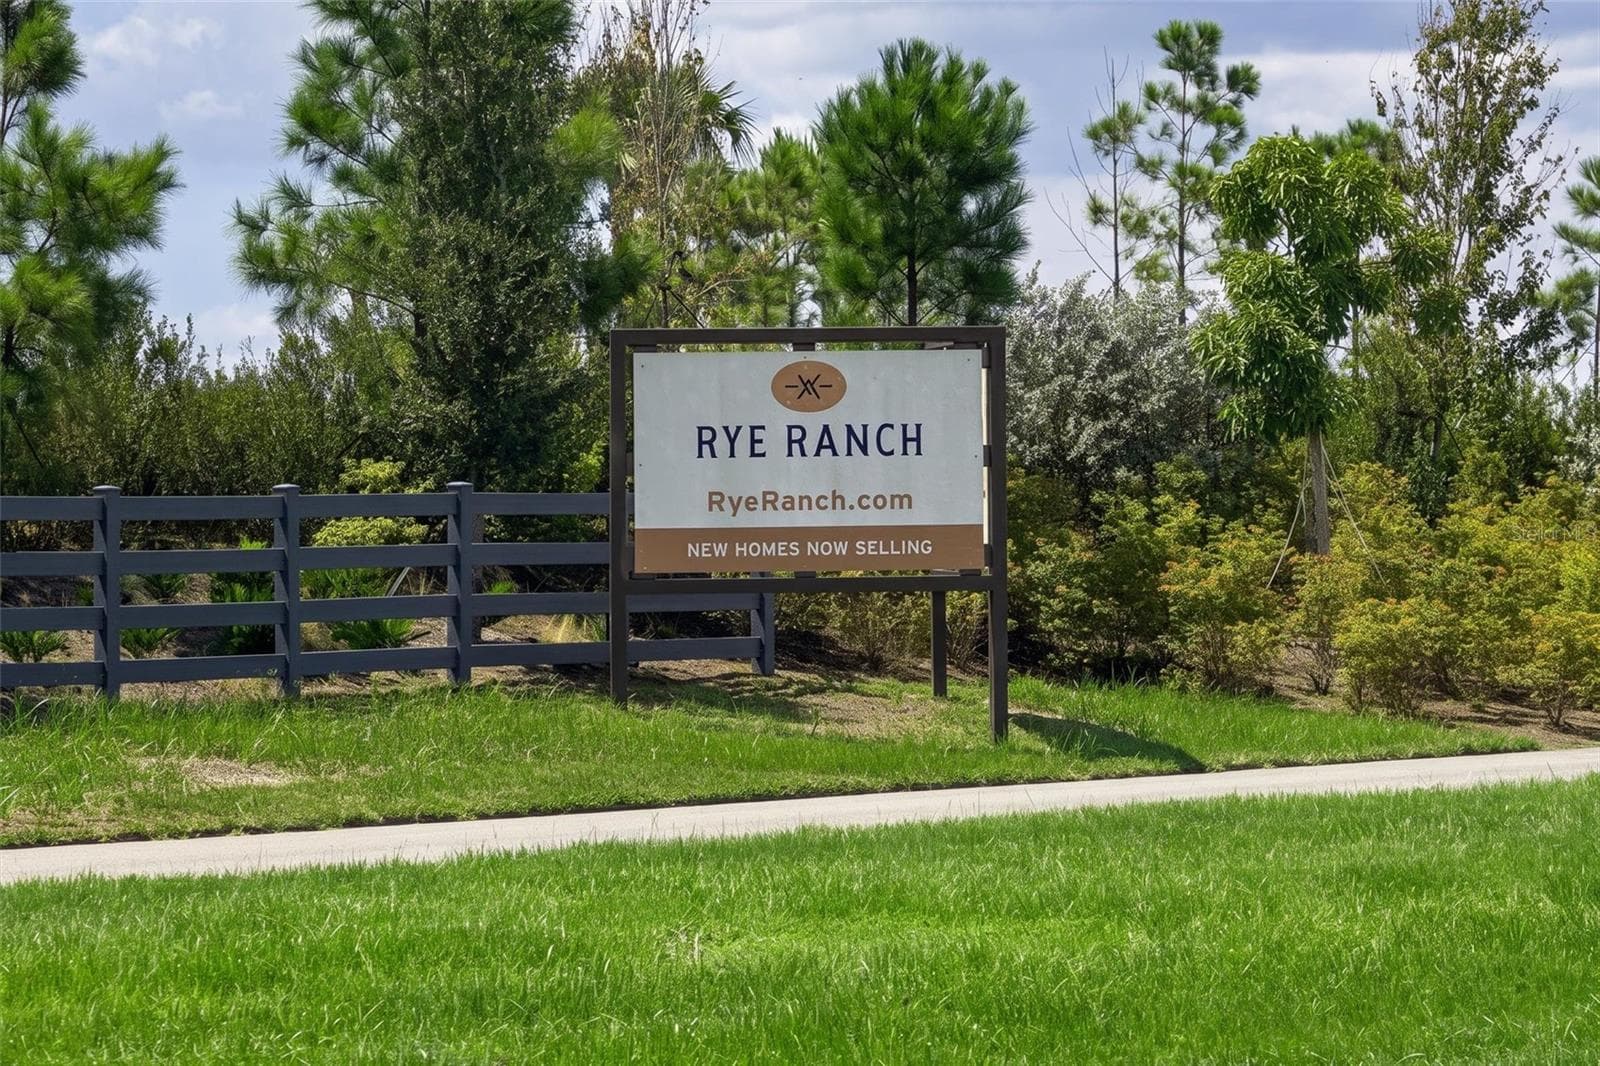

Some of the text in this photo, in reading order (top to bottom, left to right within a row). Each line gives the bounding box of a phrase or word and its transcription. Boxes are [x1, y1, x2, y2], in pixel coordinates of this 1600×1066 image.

[696, 423, 923, 458] RYE RANCH
[708, 490, 913, 517] RyeRanch.com
[688, 540, 932, 557] NEW HOMES NOW SELLING
